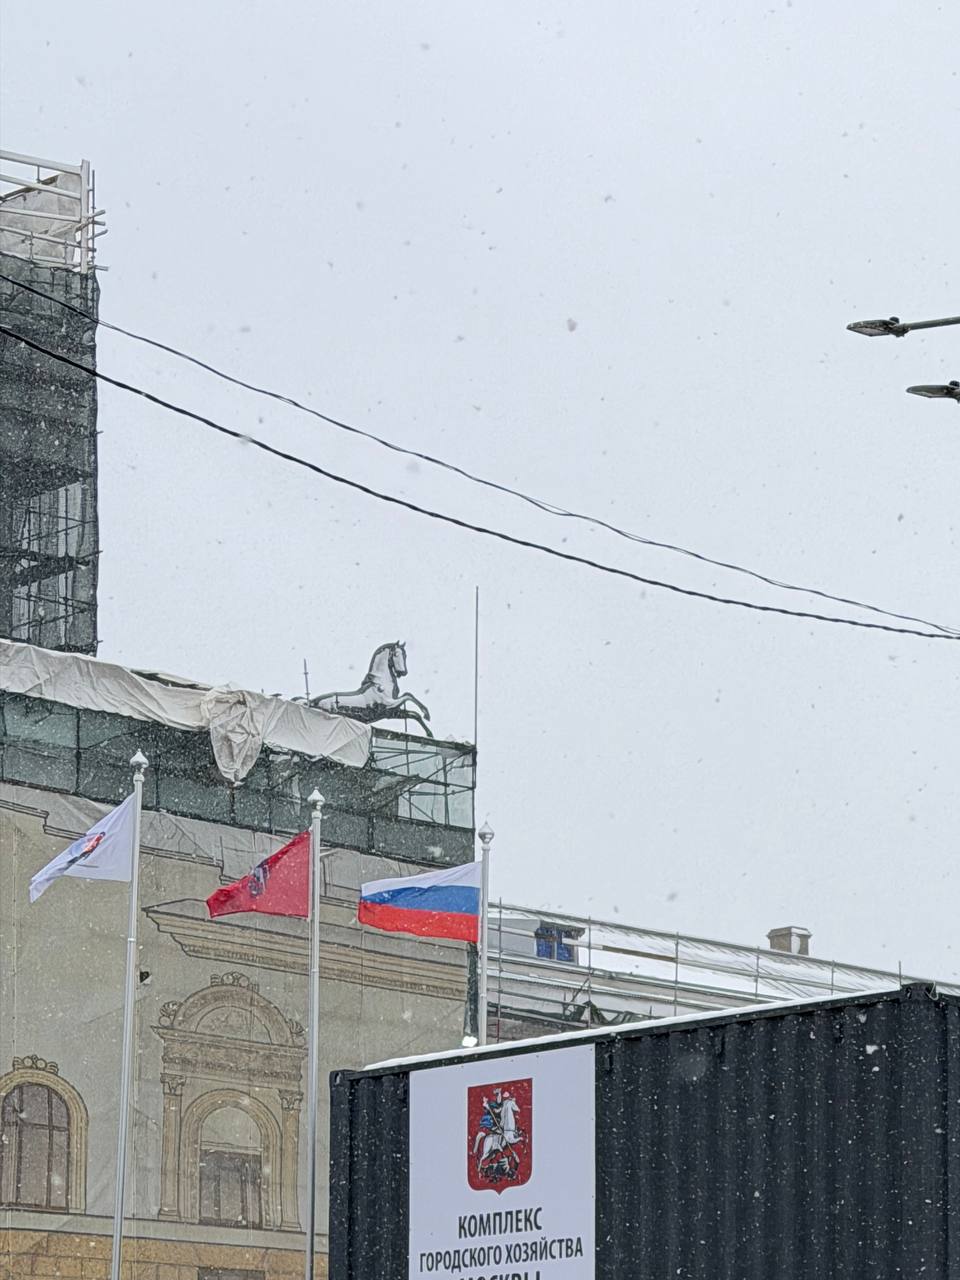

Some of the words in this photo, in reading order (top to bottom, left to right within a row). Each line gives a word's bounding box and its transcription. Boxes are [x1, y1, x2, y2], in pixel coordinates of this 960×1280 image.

[458, 1207, 543, 1239] КОМПЛЕКС
[419, 1245, 500, 1273] ГОРОДСКОГО
[505, 1236, 584, 1264] ХОЗЯЙСТВА
